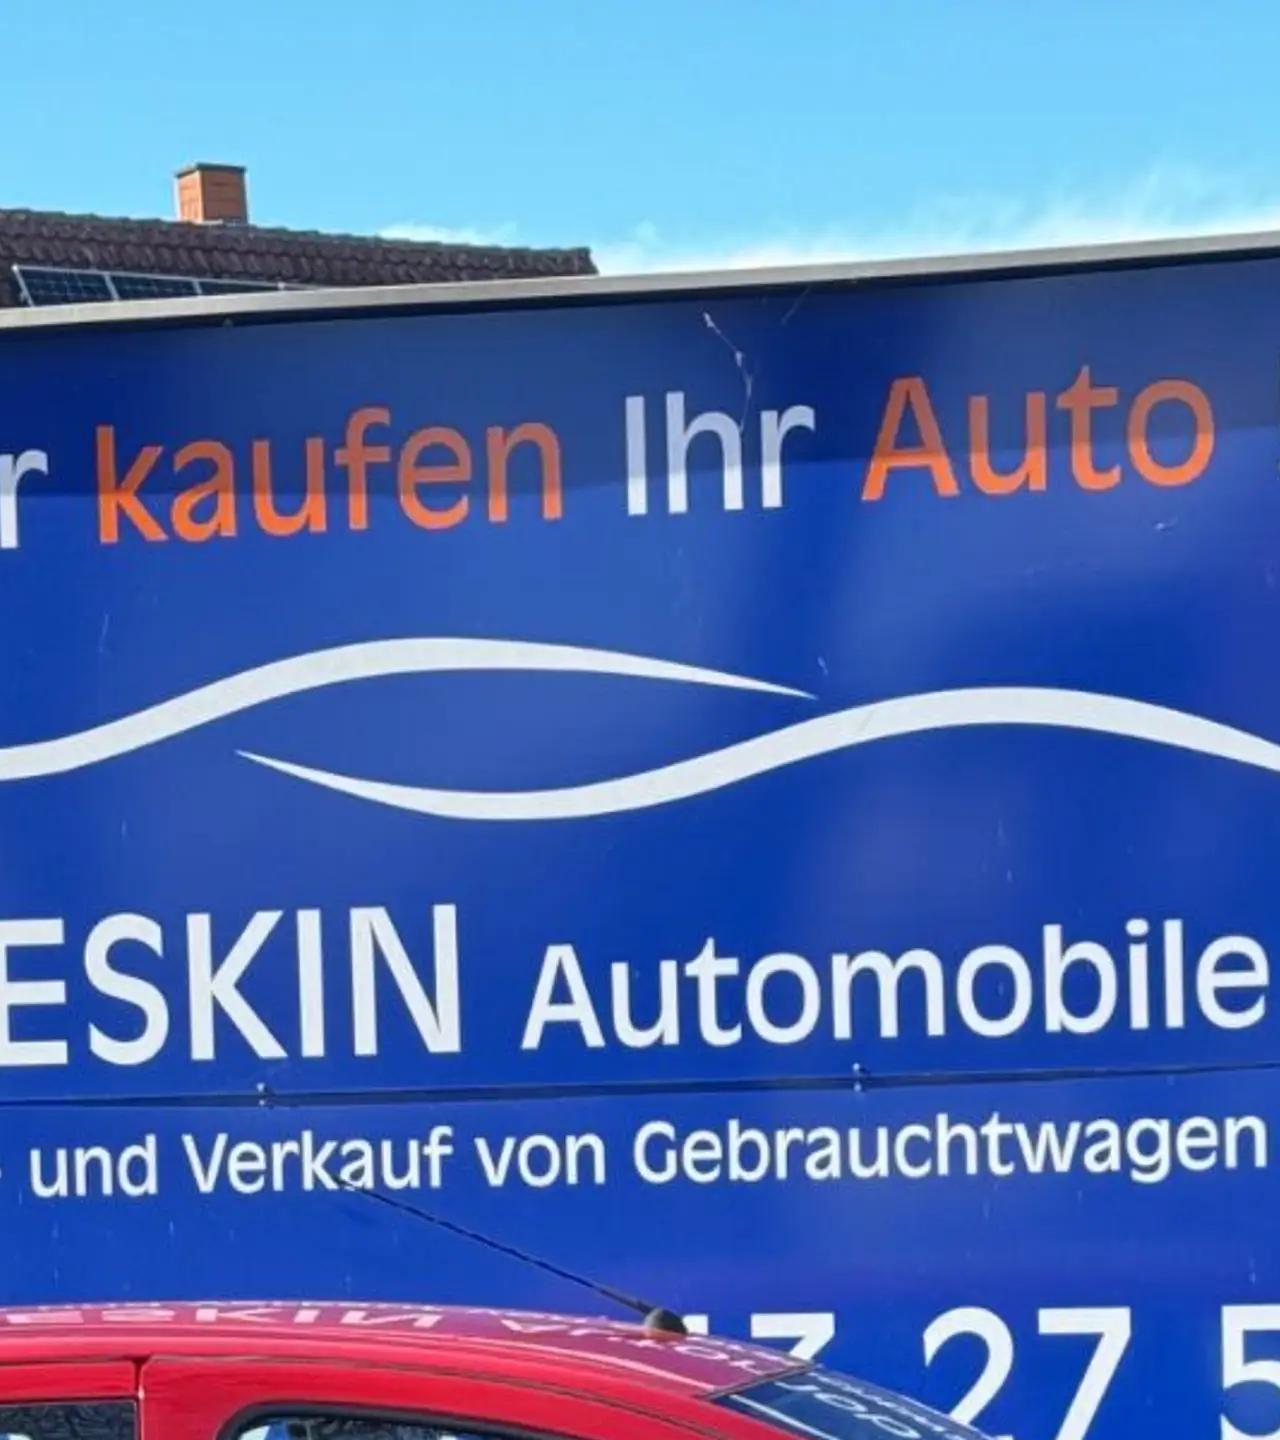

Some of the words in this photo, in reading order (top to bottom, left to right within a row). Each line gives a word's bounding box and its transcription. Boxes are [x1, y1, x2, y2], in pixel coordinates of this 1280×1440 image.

[95, 404, 565, 545] kaufen
[624, 391, 815, 516] Ihr
[860, 364, 1217, 502] Auto
[520, 918, 1271, 1050] Automobile
[29, 1132, 158, 1198] und
[181, 1124, 455, 1194] Verkauf
[473, 1132, 606, 1188] von
[632, 1111, 1268, 1184] Gebrauchtwagen
